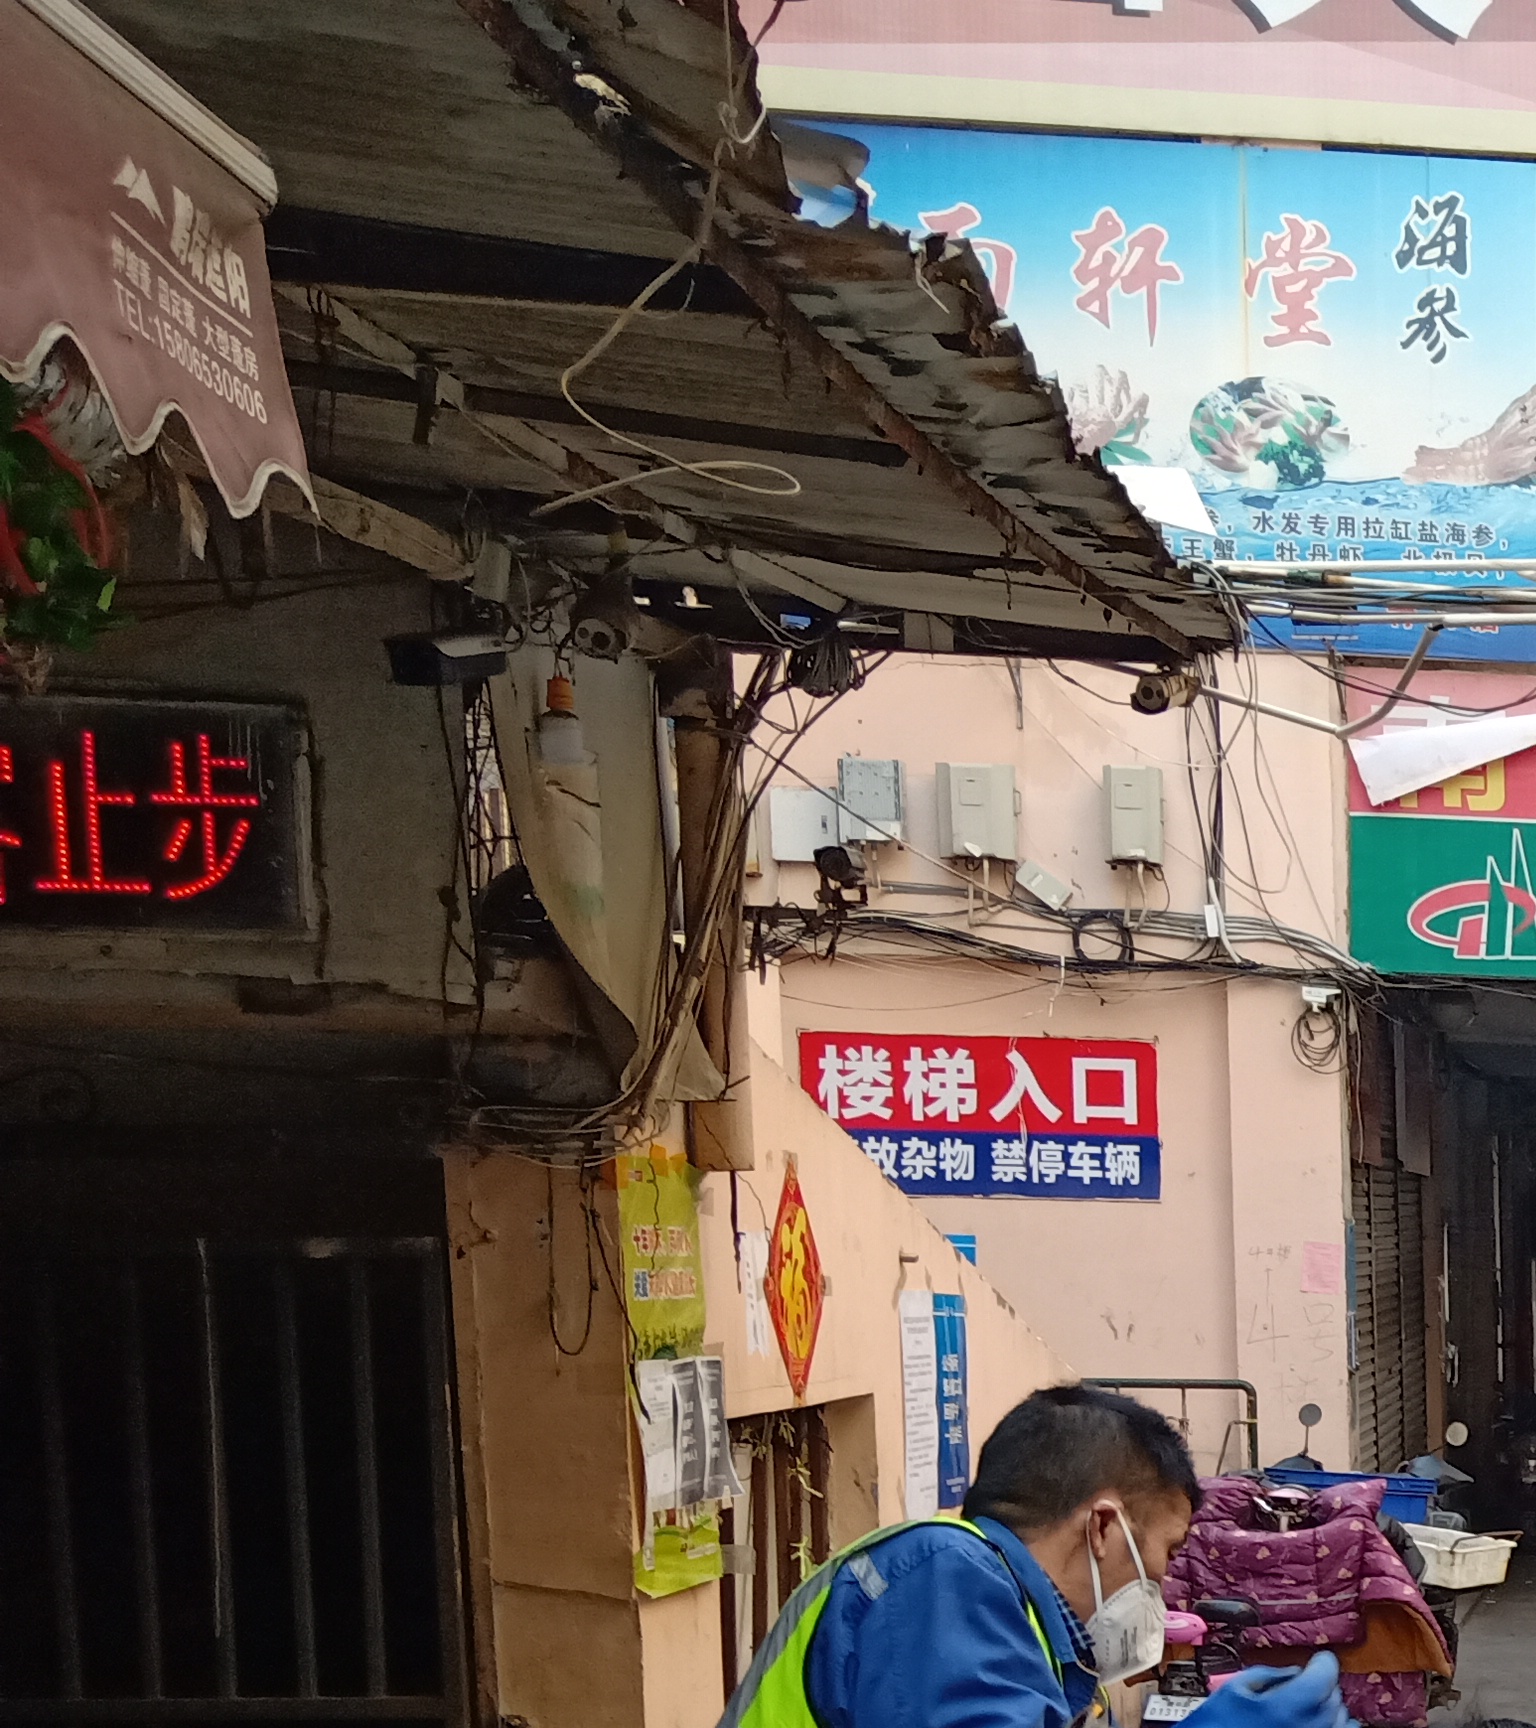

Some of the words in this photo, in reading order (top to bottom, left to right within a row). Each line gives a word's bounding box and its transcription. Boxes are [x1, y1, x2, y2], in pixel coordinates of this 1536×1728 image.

[1394, 190, 1474, 365] 海参
[0, 730, 260, 905] 止步
[817, 1043, 1139, 1126] 楼梯入口
[855, 1135, 976, 1182] 放杂物
[990, 1139, 1142, 1186] 禁停车辆
